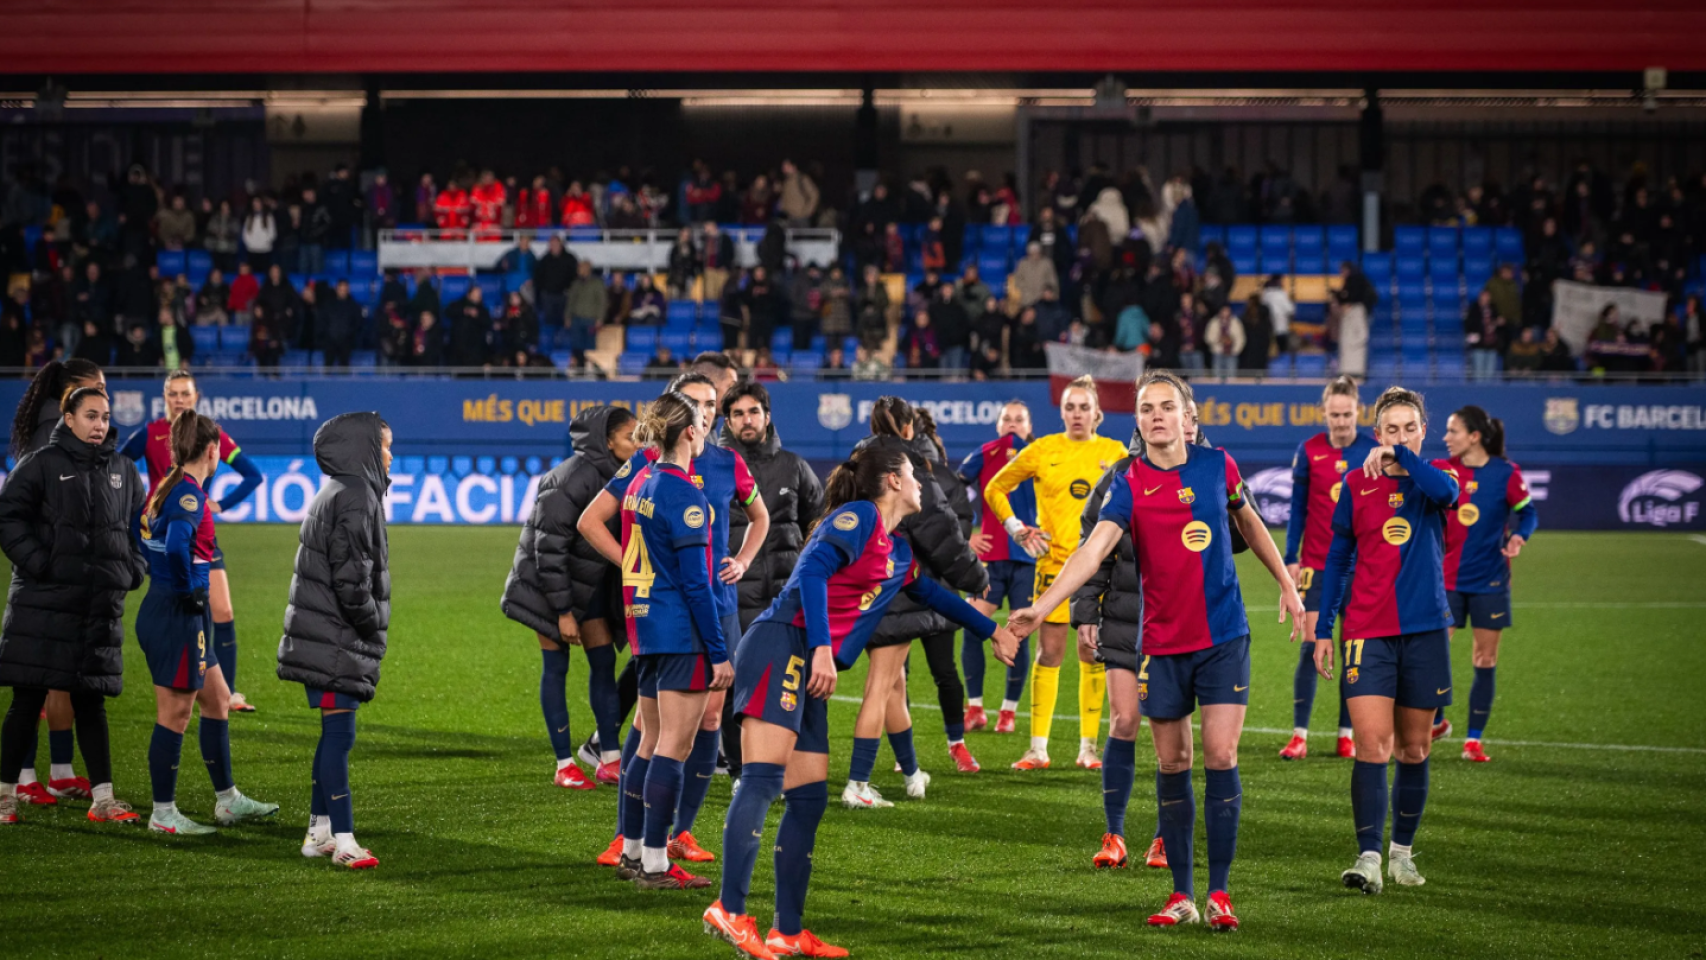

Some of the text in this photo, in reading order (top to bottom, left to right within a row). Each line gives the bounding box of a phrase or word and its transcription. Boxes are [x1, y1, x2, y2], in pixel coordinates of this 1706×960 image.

[198, 396, 318, 420] ARCELONA
[463, 393, 513, 422] MÉS
[518, 399, 566, 426] QUE
[1197, 396, 1231, 426] ÉS
[1235, 402, 1284, 430] QUE
[1584, 405, 1706, 430] FC BARCEL
[211, 459, 330, 523] CIÓ
[1260, 498, 1292, 524] iga
[1632, 500, 1700, 527] Liga F
[622, 523, 656, 598] 4
[1344, 639, 1365, 667] 11
[782, 654, 805, 691] 5
